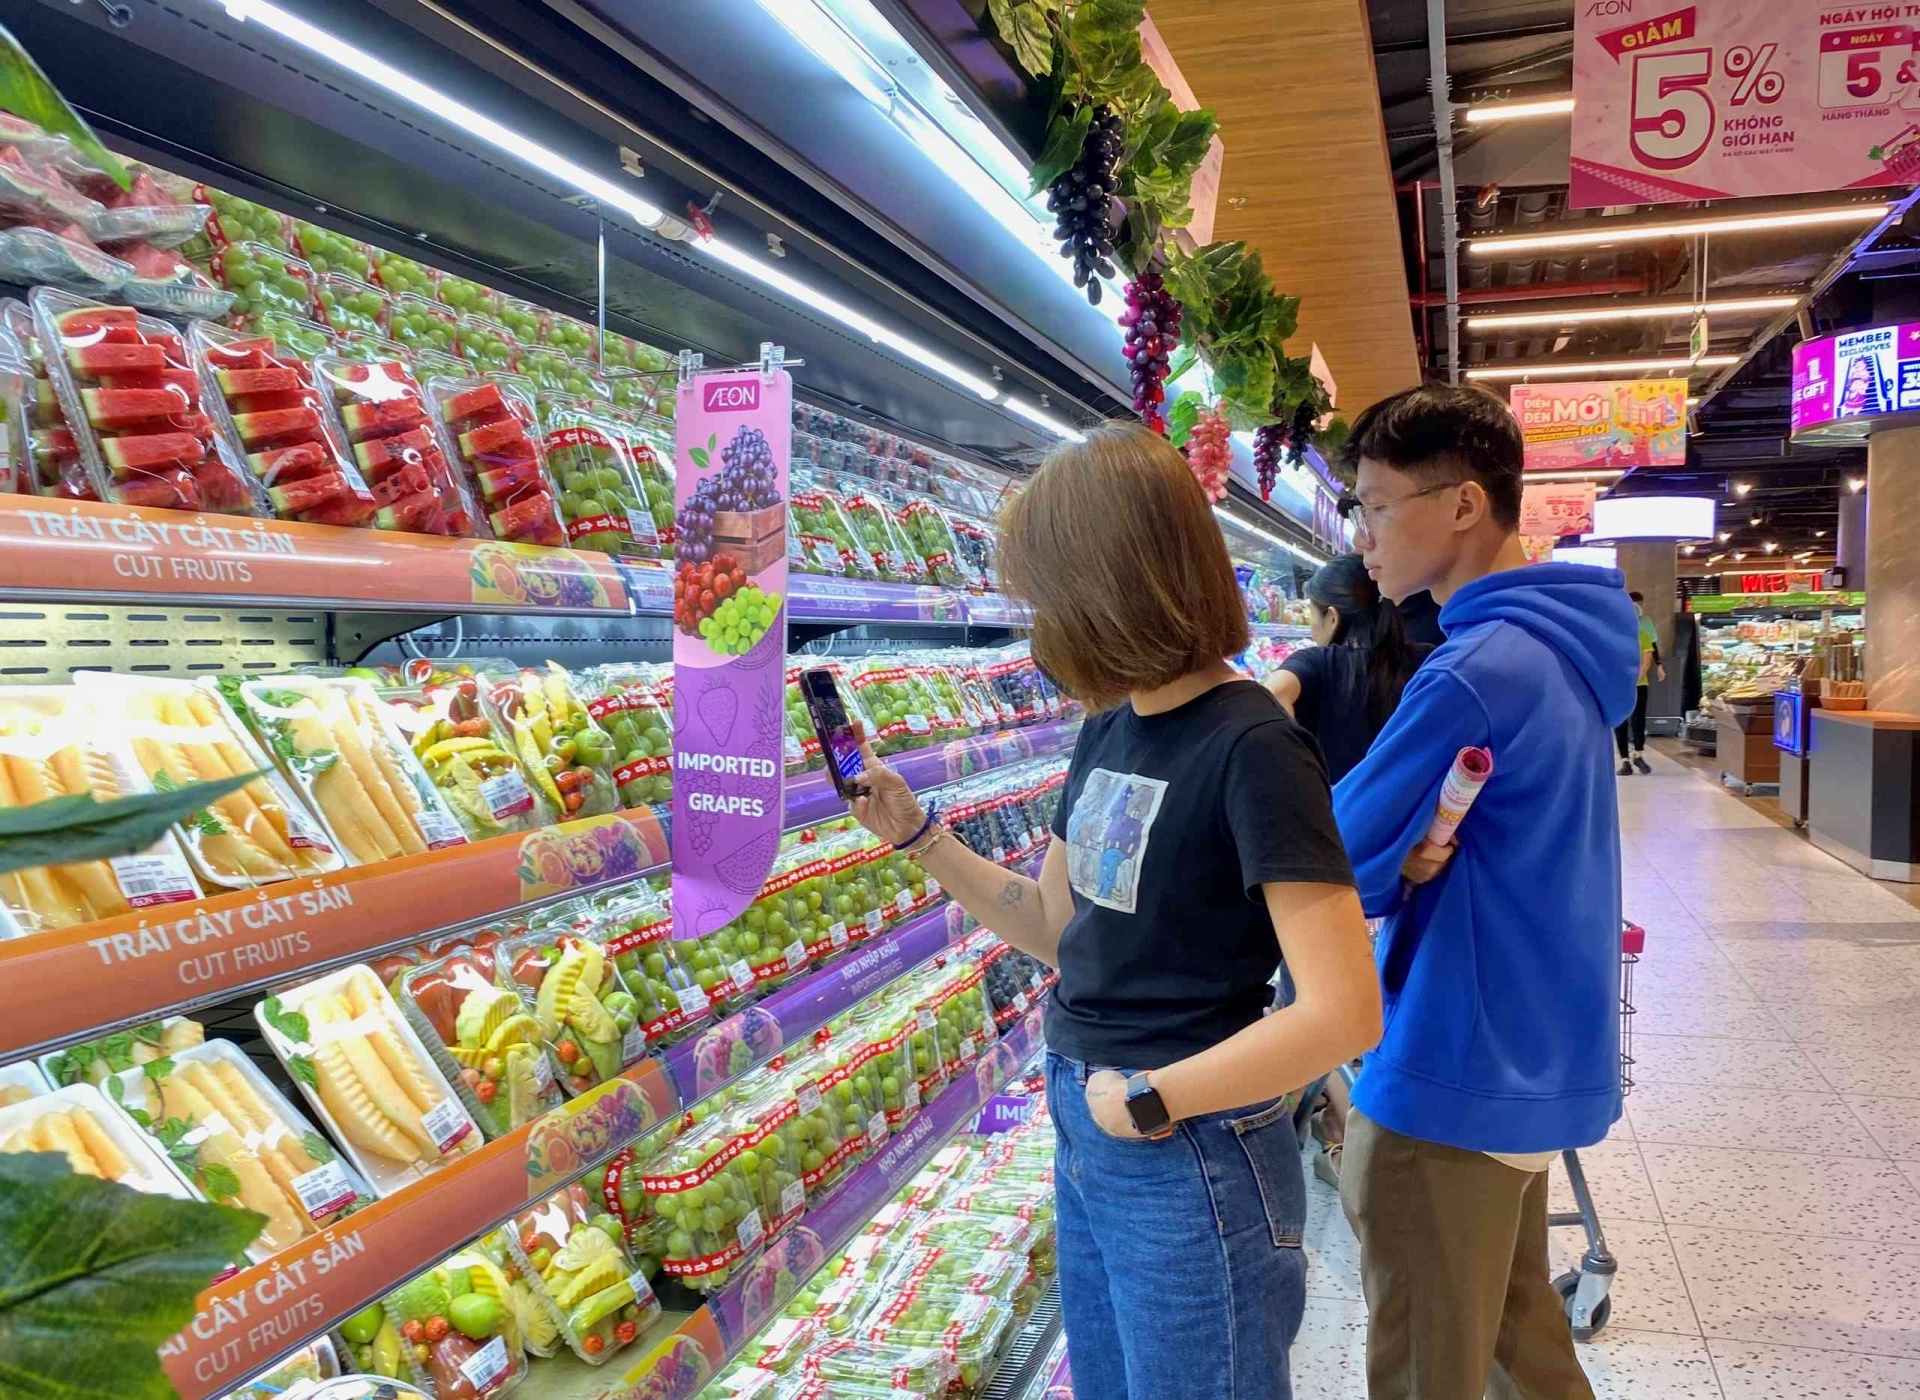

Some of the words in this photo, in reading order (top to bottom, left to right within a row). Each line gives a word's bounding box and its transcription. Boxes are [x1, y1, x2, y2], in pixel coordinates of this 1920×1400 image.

[1820, 10, 1866, 25] NGÀY
[1871, 7, 1900, 22] HỘI
[1621, 18, 1682, 48] GIẢM
[1851, 33, 1884, 45] NGÀY
[1846, 51, 1881, 97] 5
[1724, 115, 1783, 131] KHÔNG
[1822, 110, 1852, 121] HÀNG
[1854, 108, 1891, 119] THÁNG
[1722, 132, 1756, 147] GIỚI
[1759, 131, 1795, 147] HẠN
[1839, 331, 1892, 348] MEMBER
[1839, 342, 1891, 358] EXCLUSIVES
[1807, 358, 1822, 380] 1
[1803, 381, 1828, 400] GIFT
[1553, 394, 1610, 422] MỚI
[18, 507, 106, 539] TRÁI
[110, 513, 172, 545] CÂY
[179, 516, 236, 549] CẮT
[240, 521, 298, 554] SẴN
[113, 553, 164, 578] CUT
[170, 557, 253, 583] FRUITS
[678, 751, 776, 778] IMPORTED
[689, 792, 764, 817] GRAPES
[88, 919, 172, 965] TRÁI
[175, 908, 235, 945] CÂY
[241, 891, 294, 930] CẮT
[299, 879, 354, 916] SẴN
[178, 951, 227, 984] CUT
[232, 931, 311, 972] FRUITS
[192, 1290, 249, 1340] CÂY
[254, 1261, 307, 1305] CẮT
[311, 1230, 366, 1275] SẴN
[194, 1338, 241, 1382] CUT
[248, 1293, 325, 1353] FRUITS
